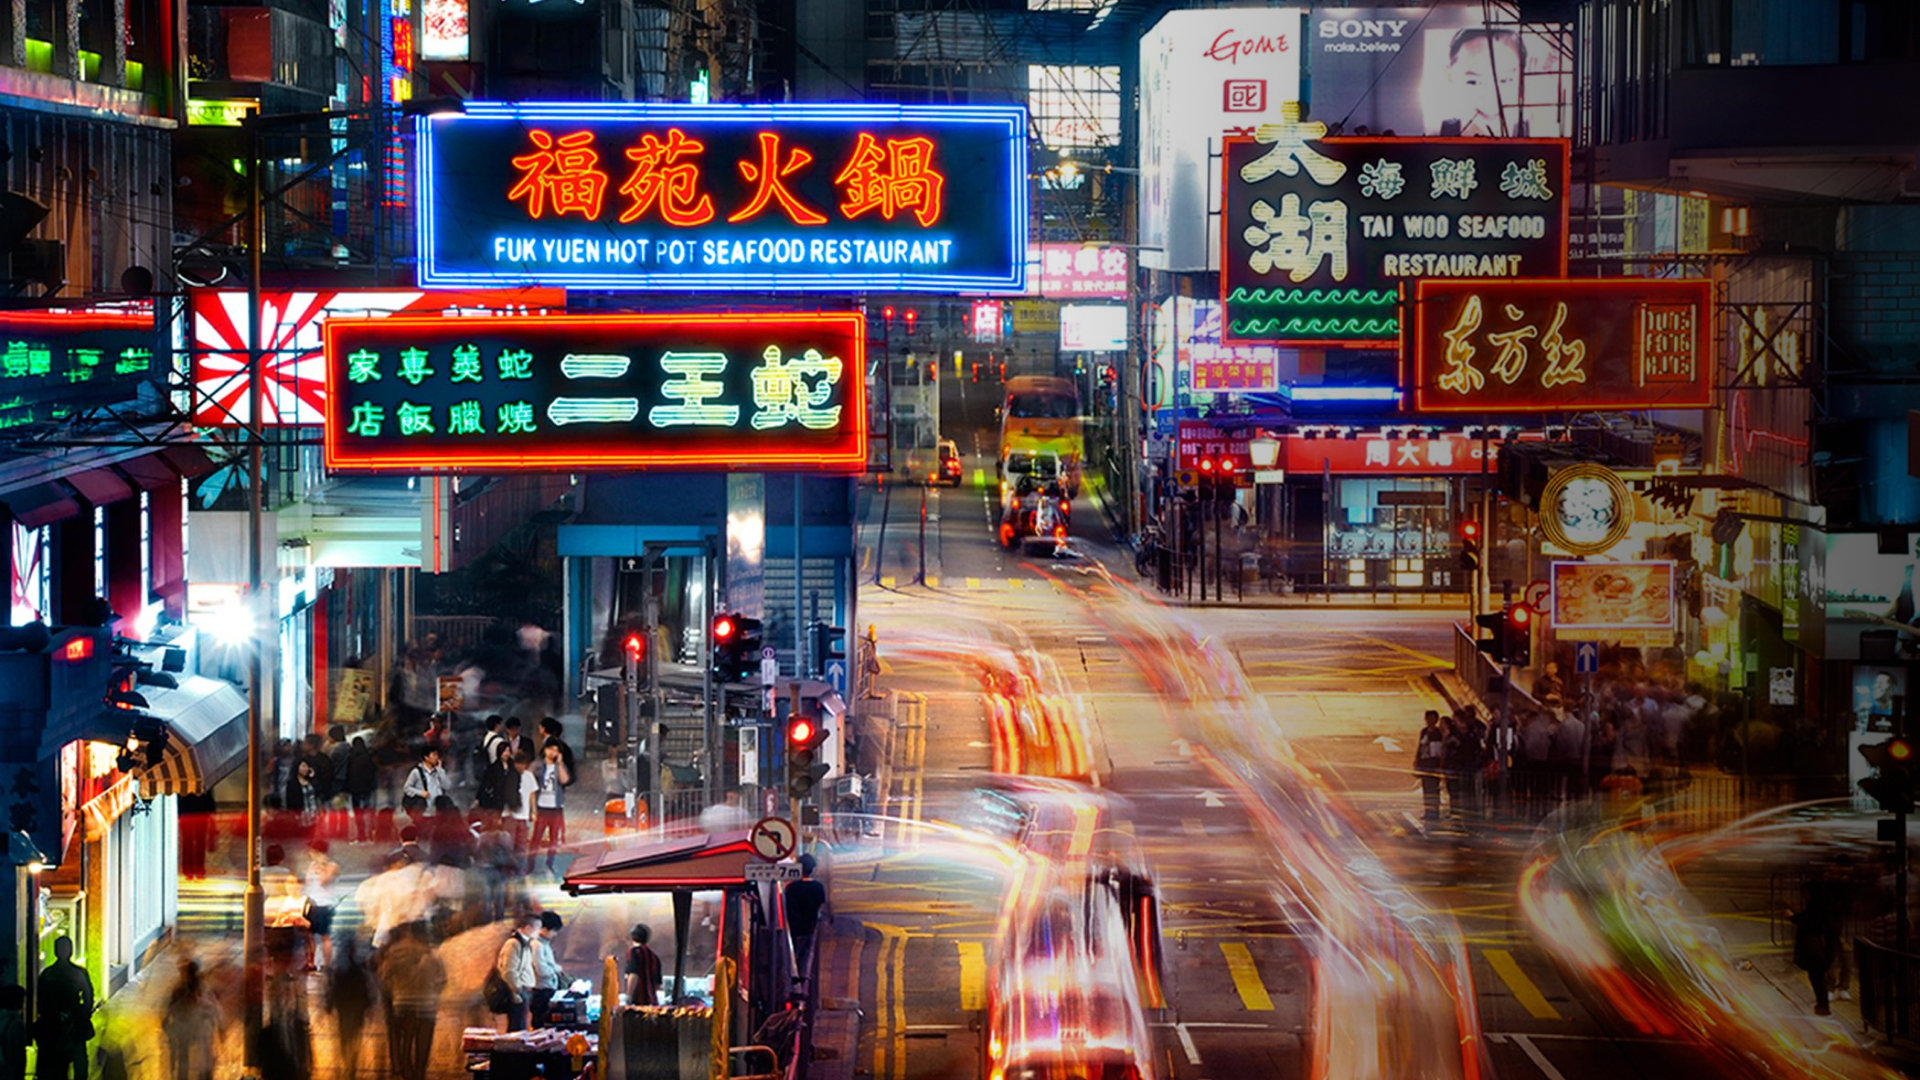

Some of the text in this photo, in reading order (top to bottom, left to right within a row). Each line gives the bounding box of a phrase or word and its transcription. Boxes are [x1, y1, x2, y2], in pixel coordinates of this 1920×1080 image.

[1318, 19, 1409, 39] SONY
[1203, 28, 1290, 65] GOME
[1323, 42, 1401, 54] make.believe
[507, 128, 945, 228] 福苑火鍋
[1357, 157, 1554, 202] 海鮮城
[1359, 214, 1394, 239] TAI
[1404, 214, 1452, 239] WOO
[1458, 214, 1546, 240] SEAFOOD
[494, 237, 952, 265] FUK YUEN HOT POT SEAFOOD RESTAURANT
[1383, 253, 1522, 279] RESTAURANT
